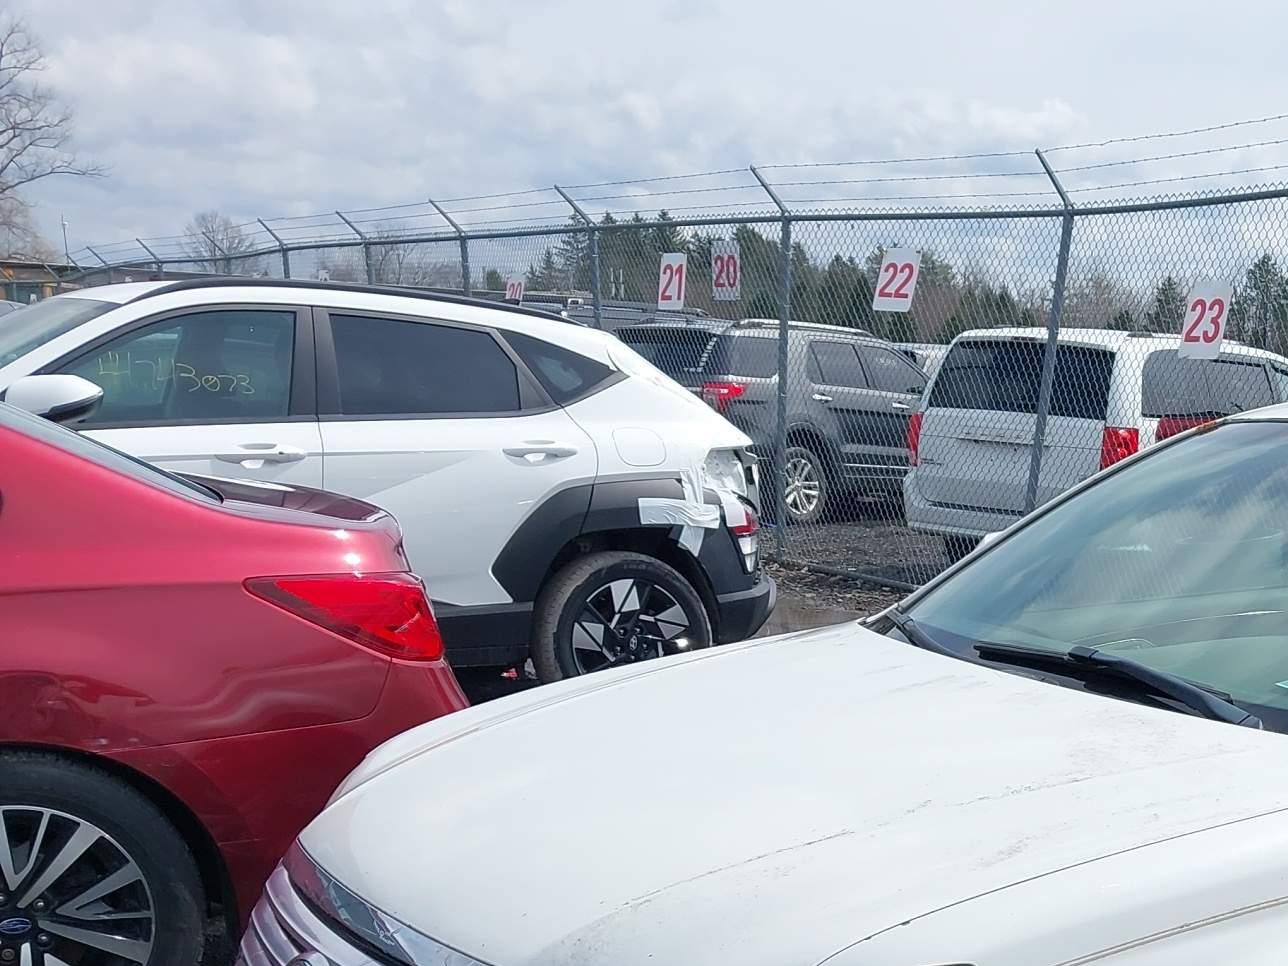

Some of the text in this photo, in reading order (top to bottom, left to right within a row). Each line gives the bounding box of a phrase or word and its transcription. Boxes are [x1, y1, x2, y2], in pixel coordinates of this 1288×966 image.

[661, 263, 685, 301] 21
[714, 254, 738, 289] 20
[877, 262, 915, 299] 22
[1183, 298, 1226, 344] 23
